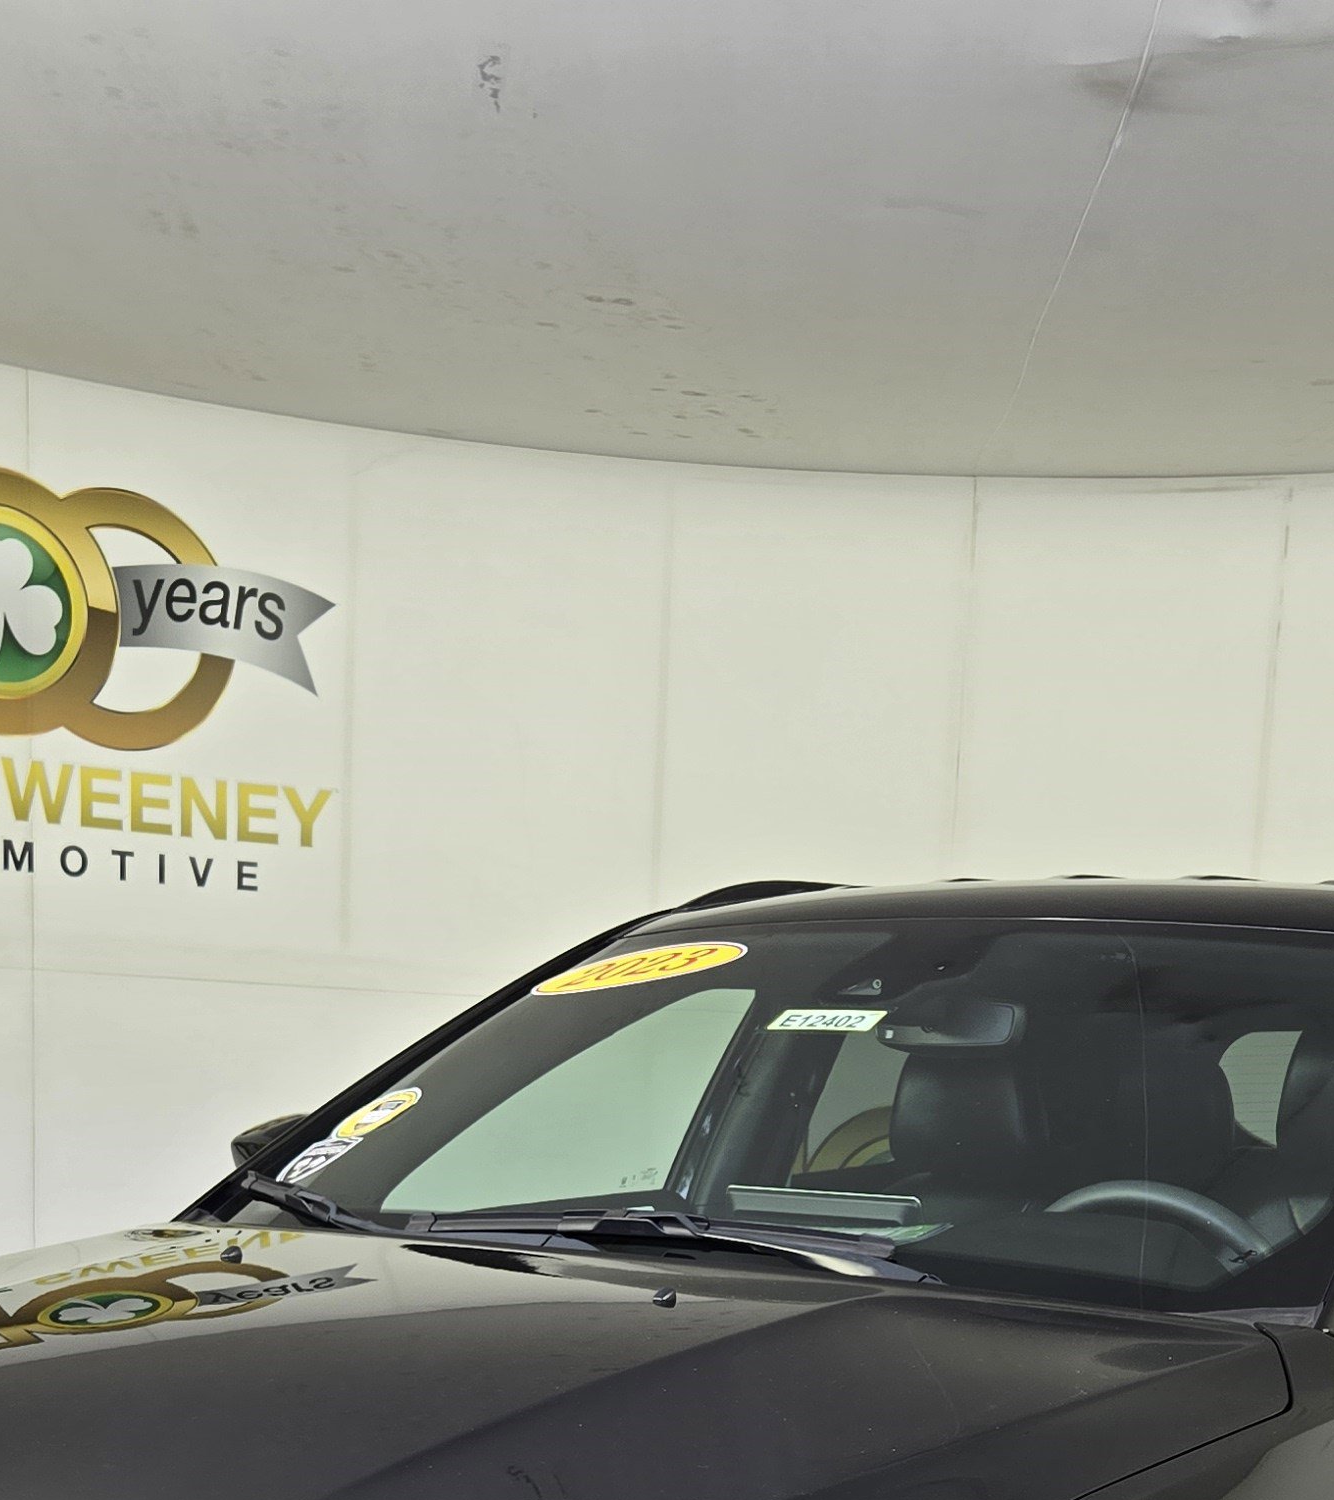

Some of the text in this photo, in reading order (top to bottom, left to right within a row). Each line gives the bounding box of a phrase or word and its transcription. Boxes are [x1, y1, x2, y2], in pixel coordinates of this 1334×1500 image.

[131, 576, 287, 641] years
[557, 947, 719, 988] 2023
[779, 1013, 866, 1030] E12402
